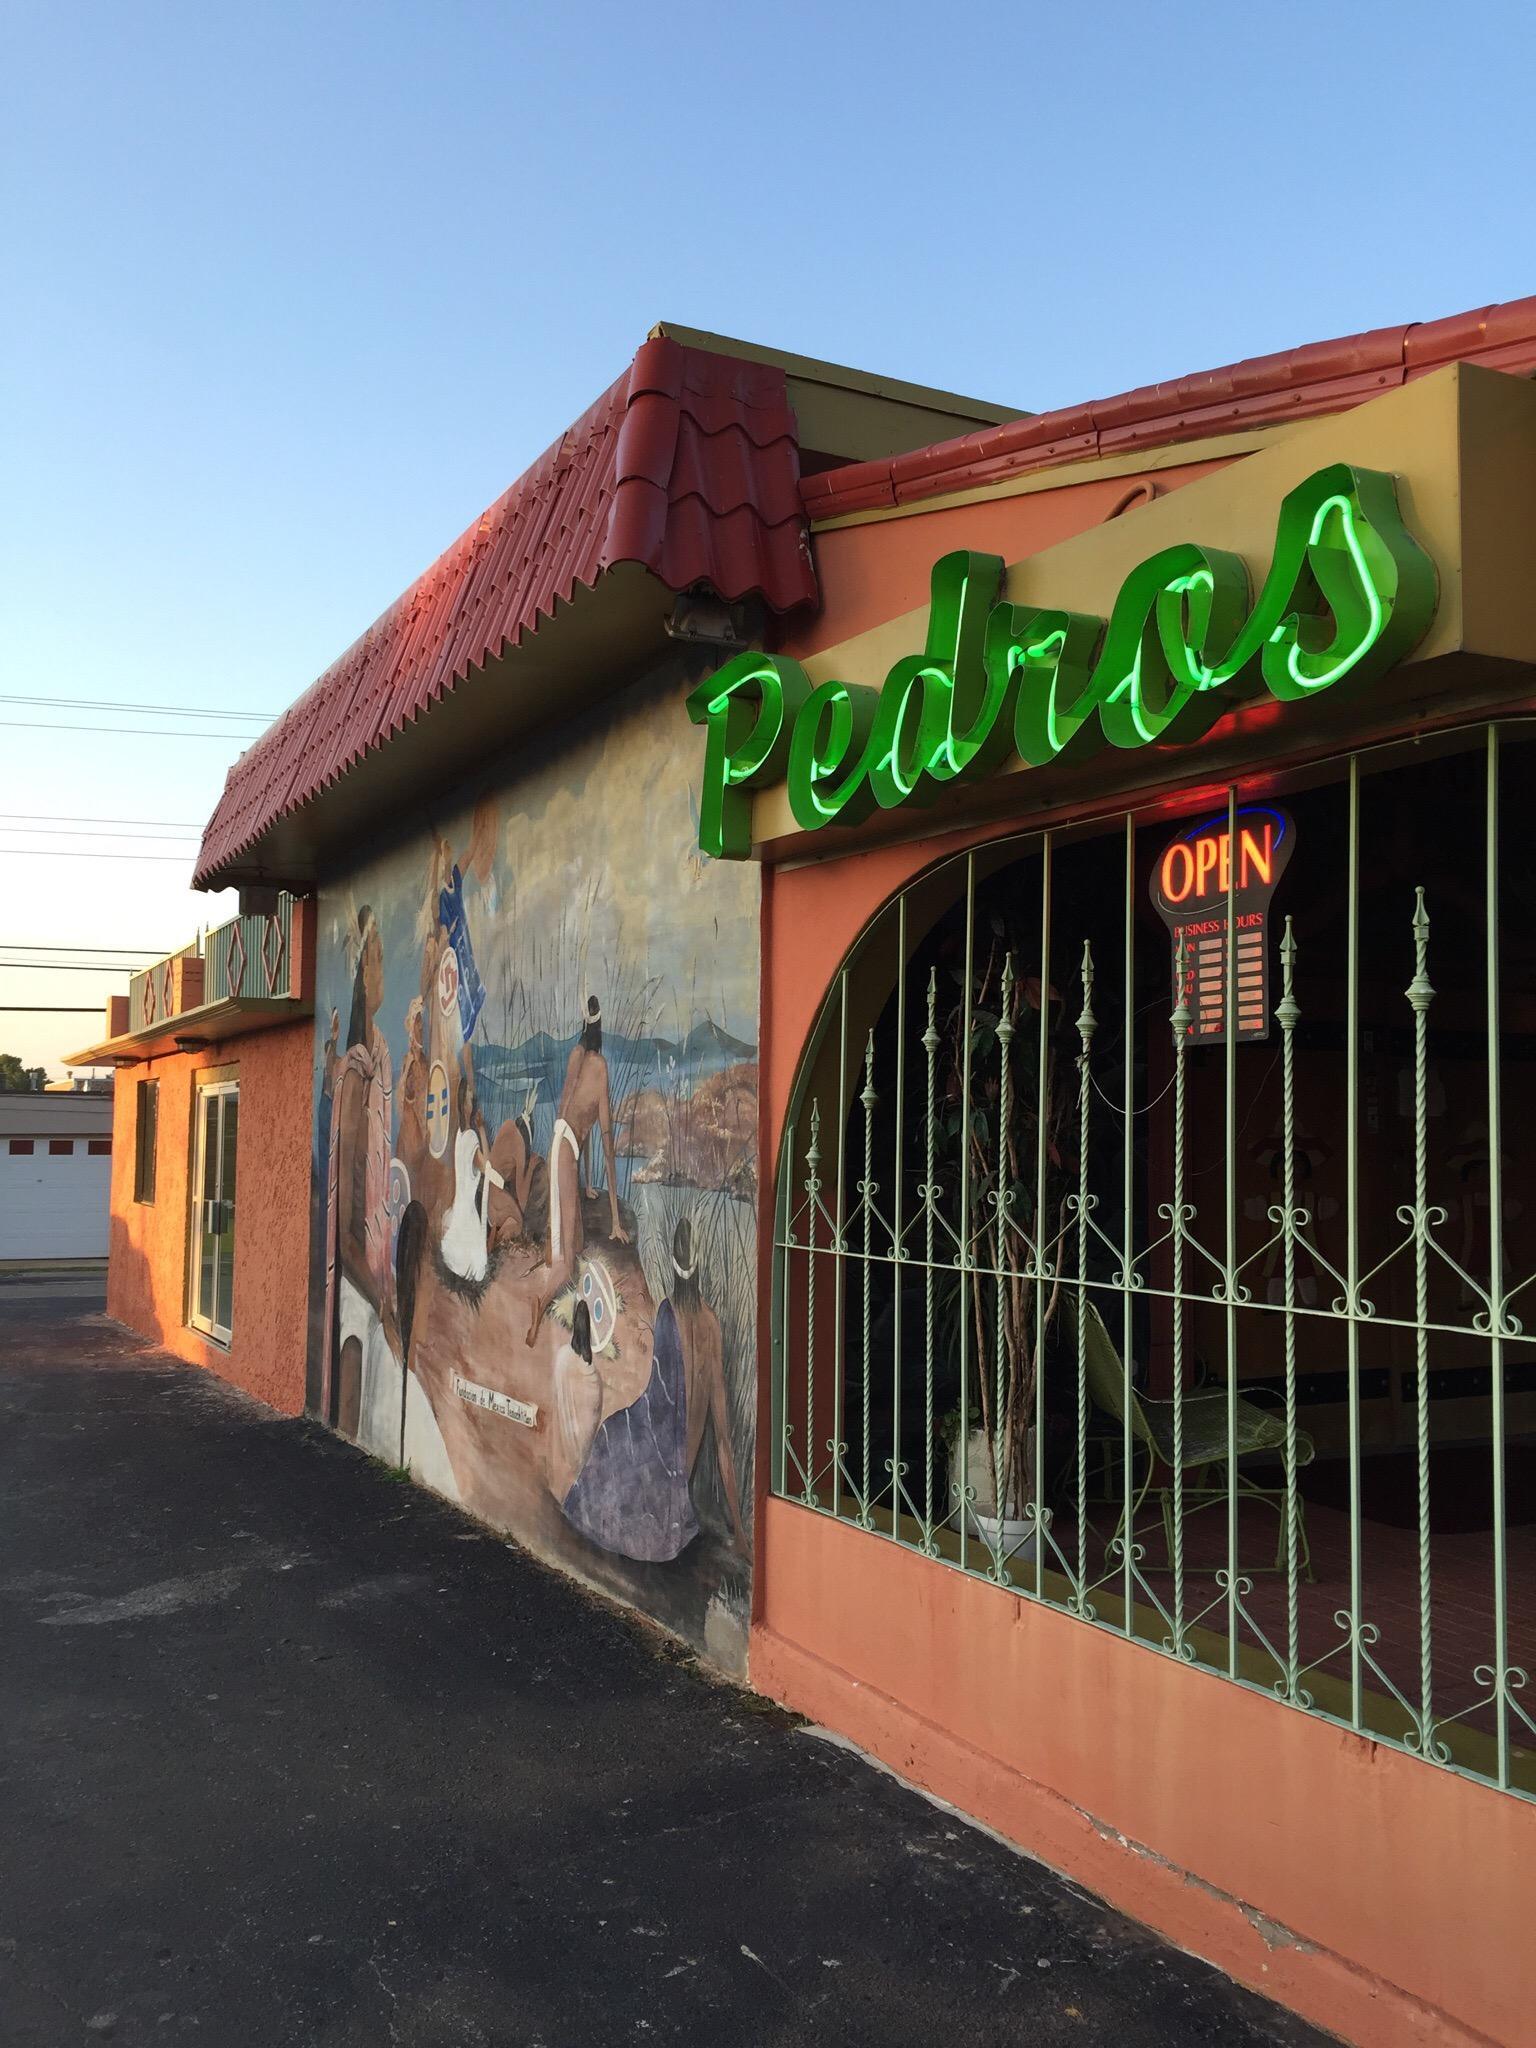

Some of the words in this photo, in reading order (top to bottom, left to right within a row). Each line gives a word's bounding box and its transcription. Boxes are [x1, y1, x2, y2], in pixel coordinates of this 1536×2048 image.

[686, 463, 1440, 860] Pedros
[1161, 824, 1272, 904] OPEN
[1174, 920, 1221, 939] BUSINESS
